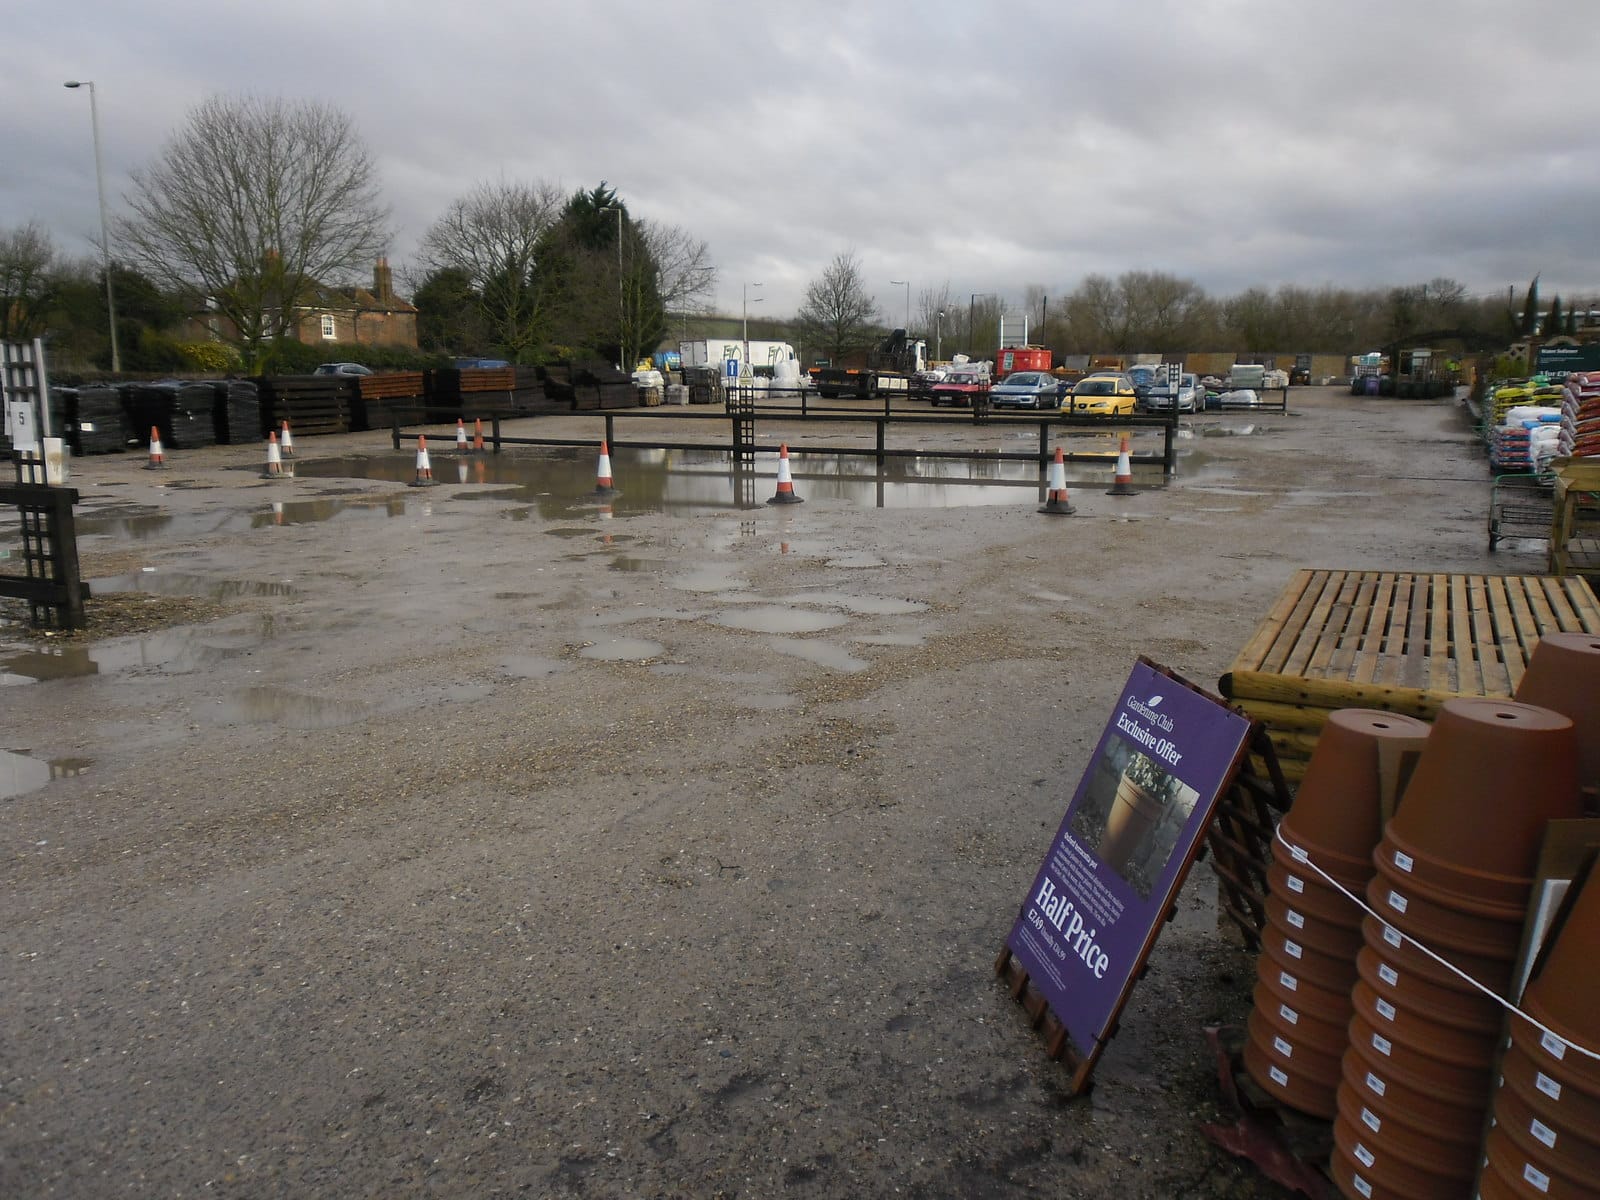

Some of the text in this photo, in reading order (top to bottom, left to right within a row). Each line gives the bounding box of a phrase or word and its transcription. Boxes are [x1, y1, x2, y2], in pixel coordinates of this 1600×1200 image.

[18, 412, 25, 425] 5
[1127, 696, 1174, 733] Gardening Club
[1116, 711, 1183, 766] Exclusive Offer
[1028, 908, 1044, 930] £7.49
[1035, 876, 1075, 932] Half
[1063, 910, 1109, 979] Price
